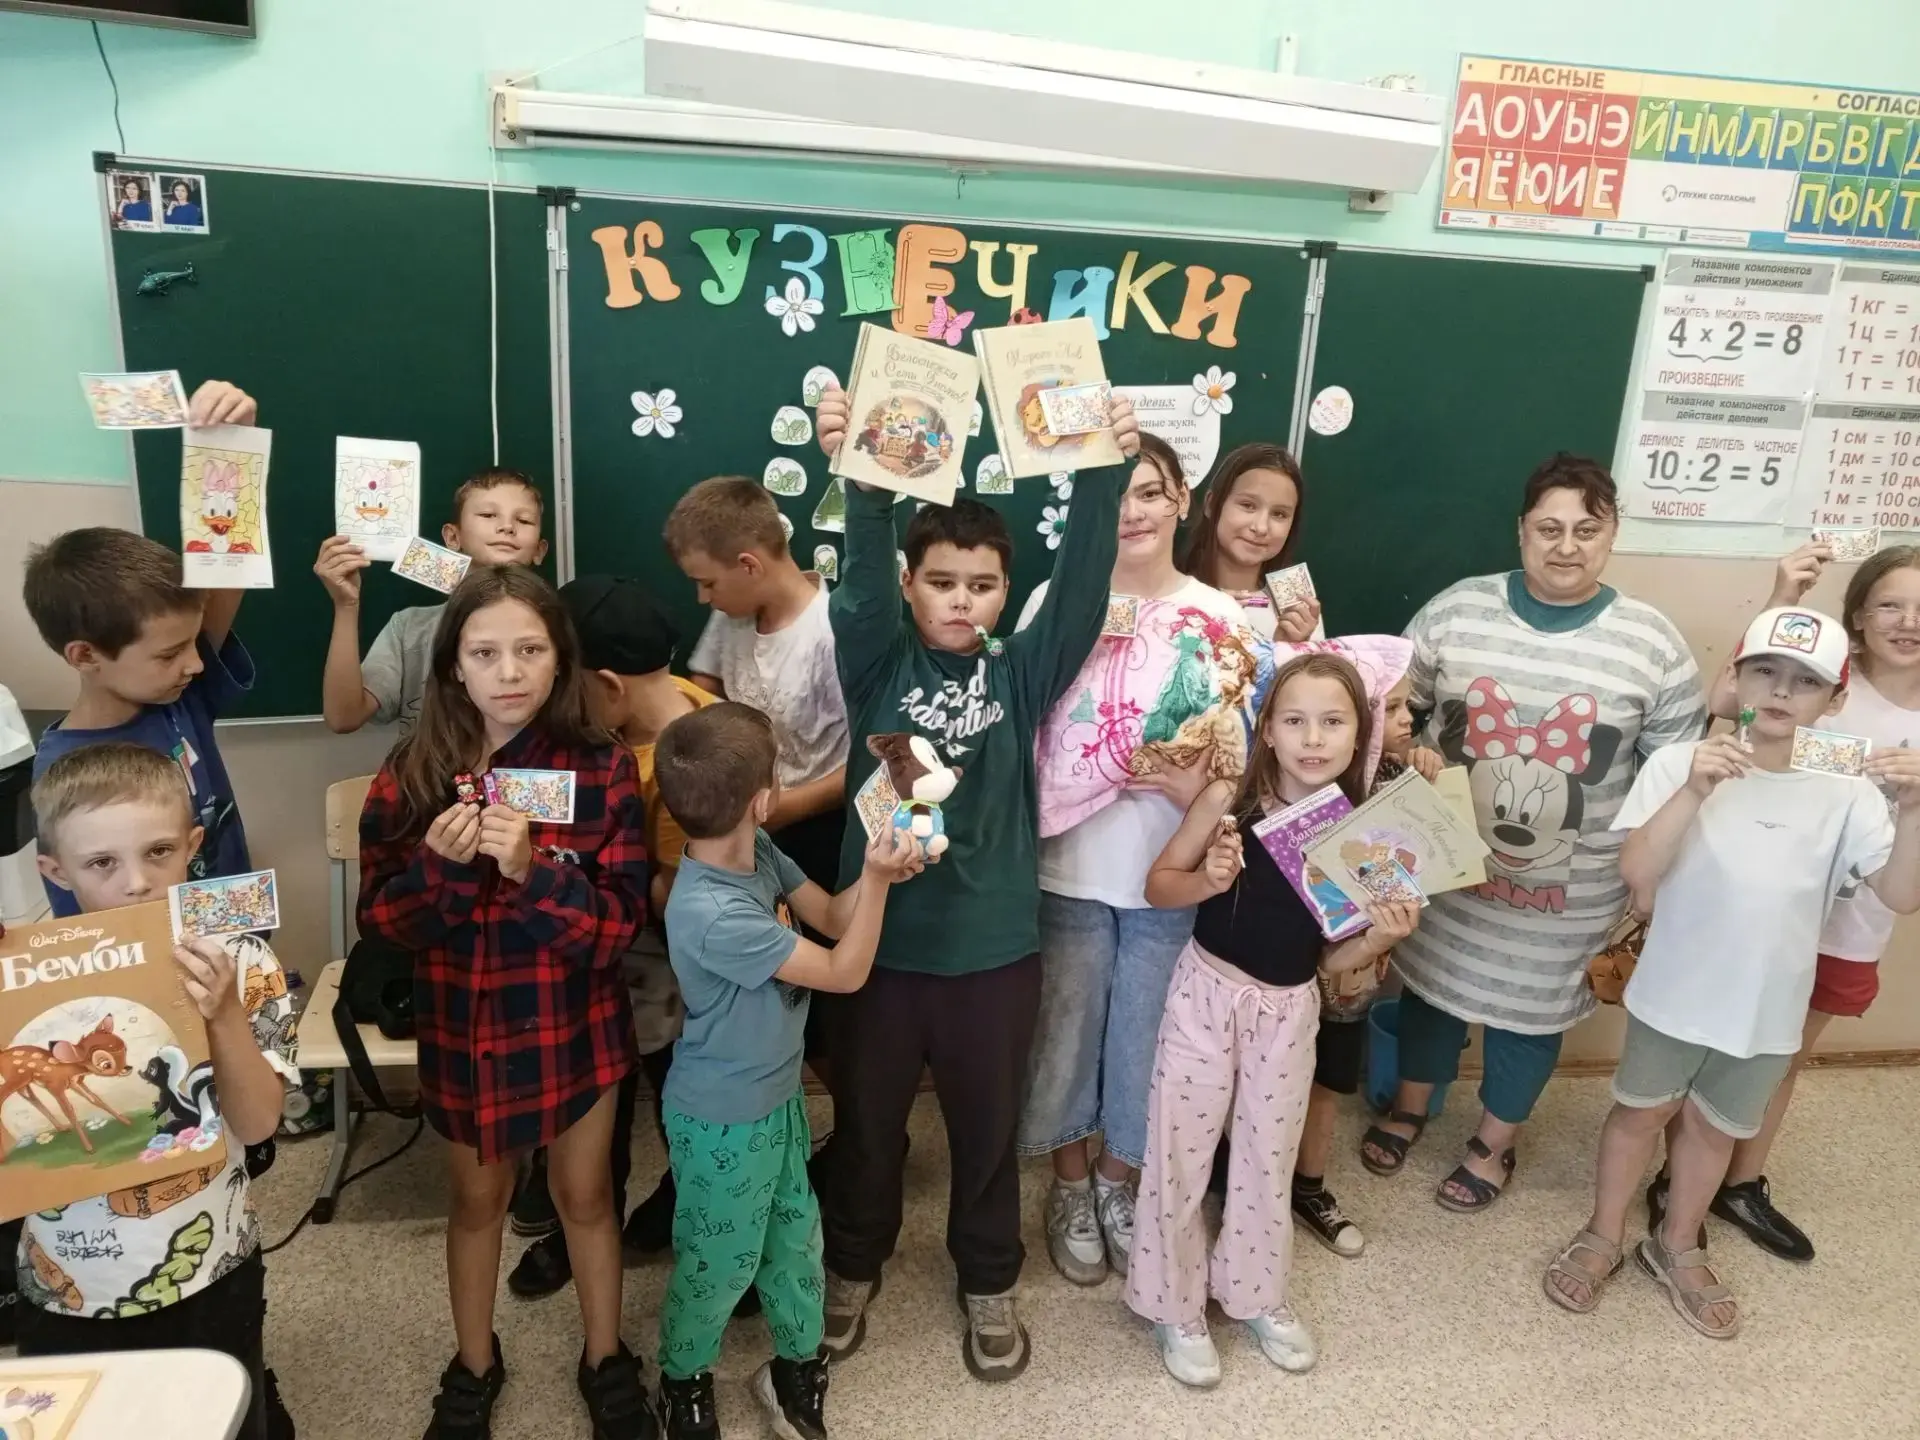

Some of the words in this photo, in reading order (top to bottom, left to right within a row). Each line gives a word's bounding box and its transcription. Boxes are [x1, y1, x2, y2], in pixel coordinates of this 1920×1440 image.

[1499, 64, 1605, 89] ГЛАСНЫЕ
[1837, 93, 1920, 115] СОГЛАС
[1709, 192, 1757, 204] СОГЛАСНЫЕ
[1691, 258, 1741, 271] Название
[1744, 263, 1813, 276] компонентов
[1693, 273, 1741, 285] действия
[1744, 277, 1804, 289] умножения
[1850, 294, 1859, 313] 1
[1668, 317, 1687, 348] 4
[1725, 320, 1746, 351] 2
[1754, 332, 1775, 347] =
[1783, 324, 1804, 355] 8
[1849, 321, 1857, 339] 1
[1838, 346, 1847, 364] 1
[1896, 349, 1920, 368] 10
[1658, 370, 1745, 387] ПРОИЗВЕДЕНИЕ
[1845, 371, 1854, 390] 1
[1665, 395, 1715, 408] Название
[1720, 401, 1787, 412] компонентов
[1676, 409, 1724, 421] действия
[1728, 414, 1769, 425] деления
[1639, 434, 1685, 448] ДЕЛИМОЕ
[1696, 437, 1745, 451] ДЕЛИТЕЛЬ
[1754, 440, 1799, 454] ЧАСТНОЕ
[1832, 428, 1839, 443] 1
[1844, 432, 1868, 445] см
[1894, 431, 1912, 446] 10
[1828, 449, 1836, 464] 1
[1891, 452, 1909, 466] 10
[1647, 450, 1679, 481] 10
[1699, 453, 1721, 482] 2
[1730, 466, 1751, 481] =
[1760, 457, 1782, 486] 5
[1828, 469, 1836, 484] 1
[1880, 471, 1898, 486] 10
[1824, 490, 1831, 504] 1
[1876, 492, 1904, 507] 100
[1652, 501, 1707, 518] ЧАСТНОЕ
[1811, 509, 1818, 525] 1
[1822, 513, 1846, 525] км
[1872, 512, 1910, 527] 1000
[1286, 816, 1335, 849] Золушка
[0, 936, 148, 993] Бемби
